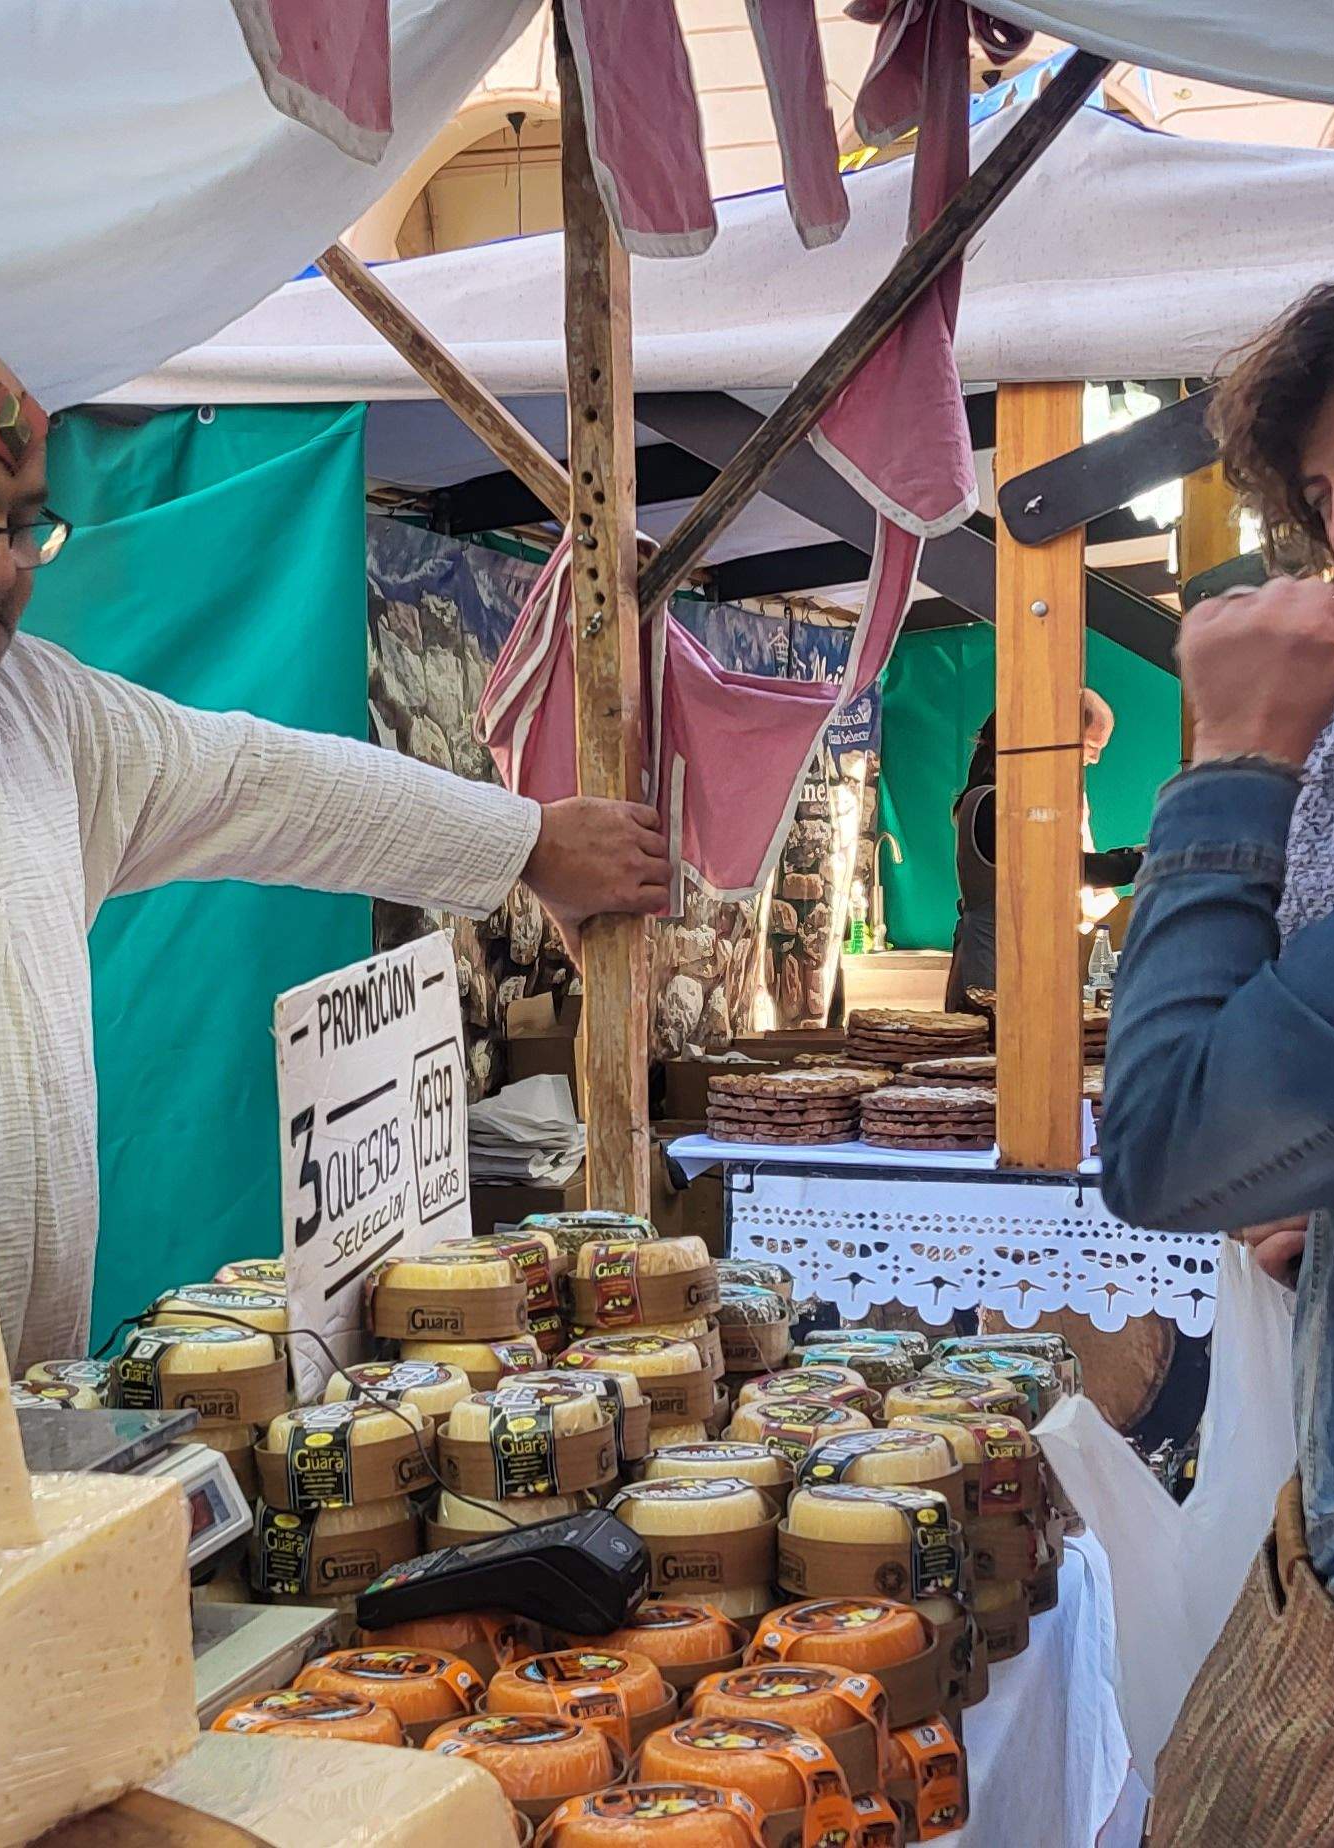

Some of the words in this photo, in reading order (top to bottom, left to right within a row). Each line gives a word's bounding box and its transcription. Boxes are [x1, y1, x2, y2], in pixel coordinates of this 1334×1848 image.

[290, 1104, 323, 1248] 3
[326, 1117, 401, 1222] QUESOS
[423, 1168, 460, 1209] EUROS
[324, 1180, 411, 1268] SELECCION
[411, 1309, 459, 1330] Guara
[499, 1434, 548, 1456] Guara
[295, 1449, 345, 1473] Guara
[266, 1528, 304, 1558] Guara
[321, 1557, 376, 1580] Guara
[662, 1555, 717, 1580] Guara
